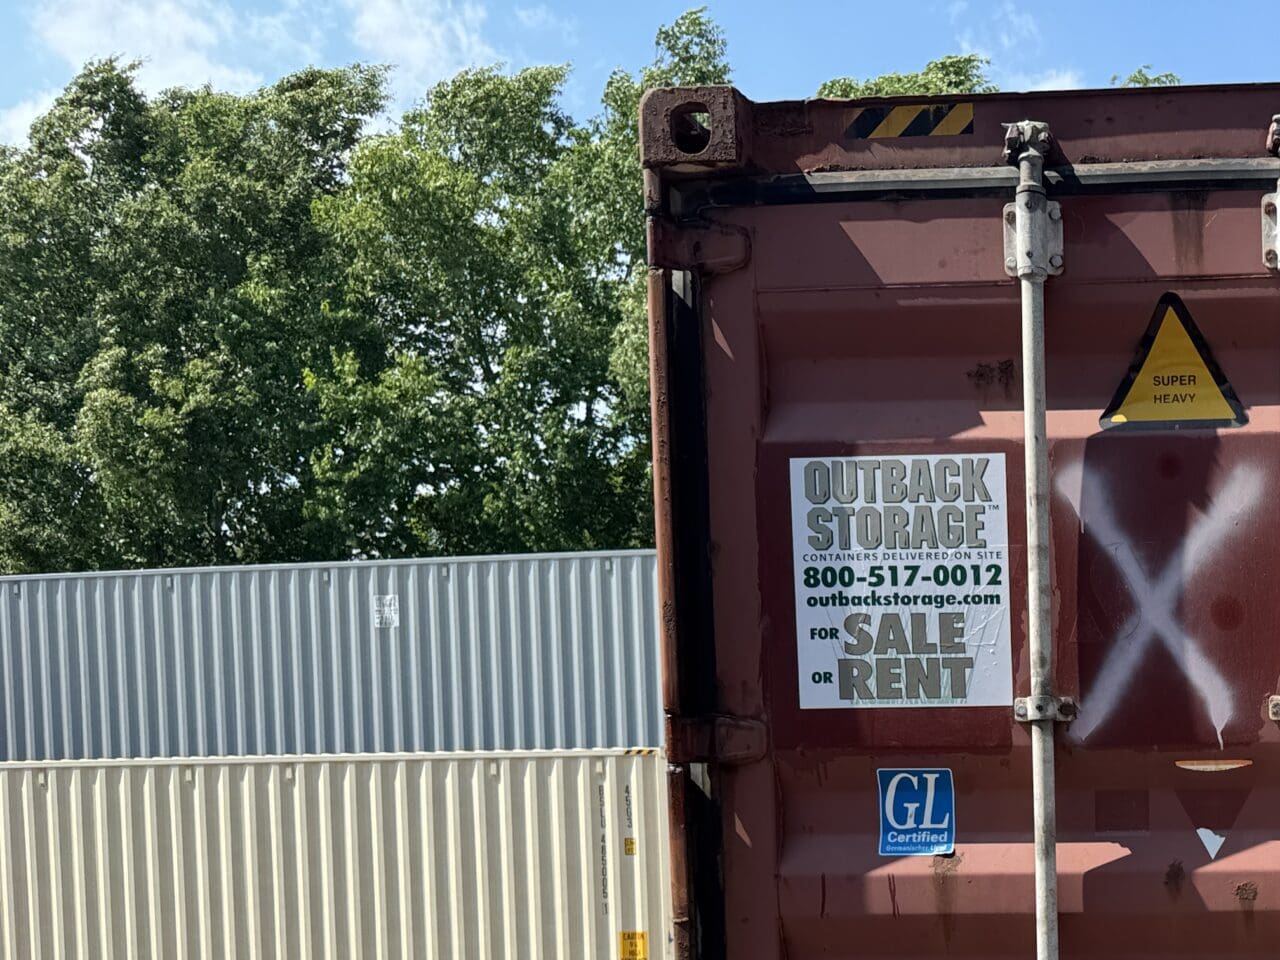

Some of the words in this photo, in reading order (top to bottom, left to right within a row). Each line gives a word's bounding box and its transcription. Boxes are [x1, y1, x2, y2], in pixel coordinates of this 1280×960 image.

[1152, 375, 1197, 386] SUPER
[1152, 394, 1197, 404] HEAVY
[804, 458, 993, 504] OUTBACK
[807, 504, 986, 550] STORAGE
[803, 552, 878, 563] CONTAINERS
[883, 551, 949, 561] DELIVERED
[950, 551, 971, 560] ON
[977, 551, 1002, 560] SITE
[803, 564, 1002, 588] 800-517-0012
[806, 590, 1001, 609] outbackstorage.com
[810, 627, 839, 640] FOR
[843, 612, 966, 655] SALE
[811, 671, 833, 684] OR
[838, 657, 973, 700] RENT
[885, 772, 949, 829] GL
[887, 831, 948, 843] Certified
